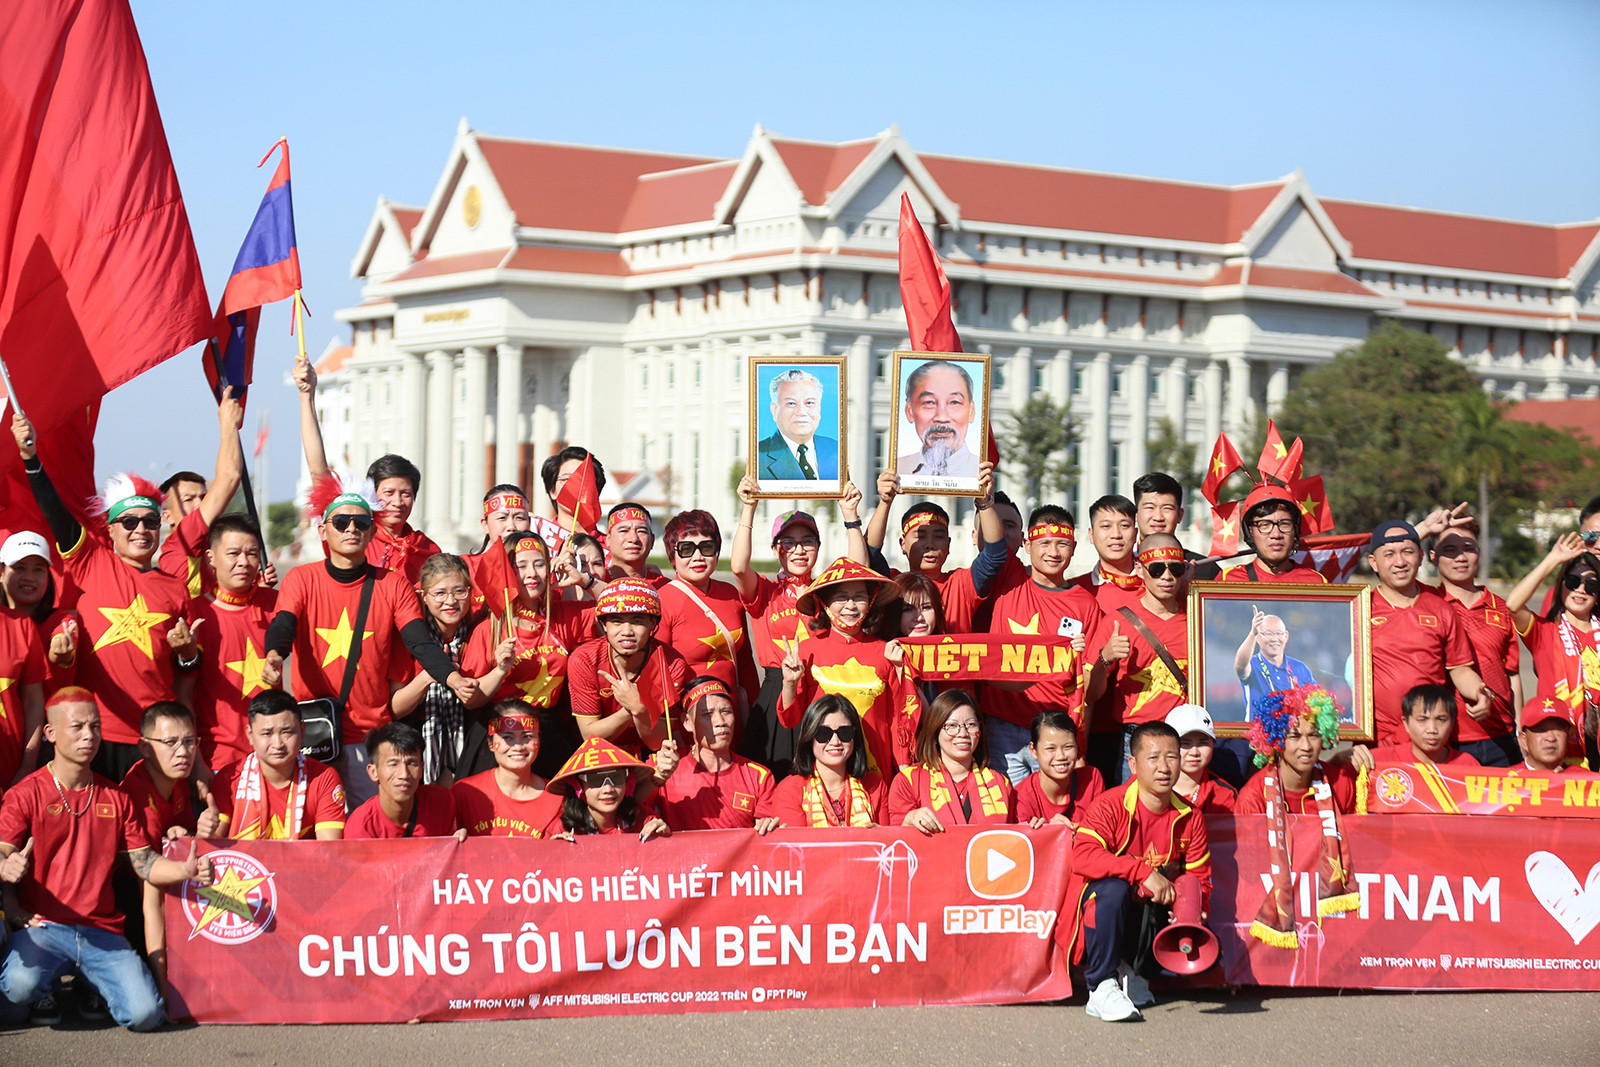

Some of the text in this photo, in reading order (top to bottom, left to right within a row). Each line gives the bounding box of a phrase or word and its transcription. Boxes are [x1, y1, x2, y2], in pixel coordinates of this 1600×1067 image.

[1147, 548, 1167, 559] YÊU
[902, 636, 1078, 680] VIỆT NAM
[520, 717, 534, 730] VIỆ
[1464, 770, 1600, 813] VIỆT NA
[489, 815, 509, 829] YÊU
[510, 819, 531, 833] VIỆT
[530, 828, 543, 840] NA
[433, 864, 803, 905] HÃY CỐNG HIẾN HẾT MÌNH
[946, 907, 1053, 936] FPT Play
[298, 914, 927, 977] CHÚNG TÔI LUÔN BÊN BẠN
[1360, 956, 1382, 967] XEM
[1384, 957, 1413, 969] TRỌN
[1454, 957, 1475, 968] AFF
[1476, 957, 1532, 969] MITSUBISHI
[1533, 958, 1581, 970] ELECTRIC
[449, 999, 471, 1010] XEM
[473, 998, 500, 1010] TRỌN
[542, 995, 563, 1007] AFF
[564, 993, 621, 1006] MITSUBISHI
[621, 991, 670, 1004] ELECTRIC
[671, 991, 694, 1003] CUP
[695, 990, 720, 1002] 2022
[721, 989, 748, 1001] TRÊN
[766, 988, 786, 1000] FPT
[786, 988, 807, 1001] Play
